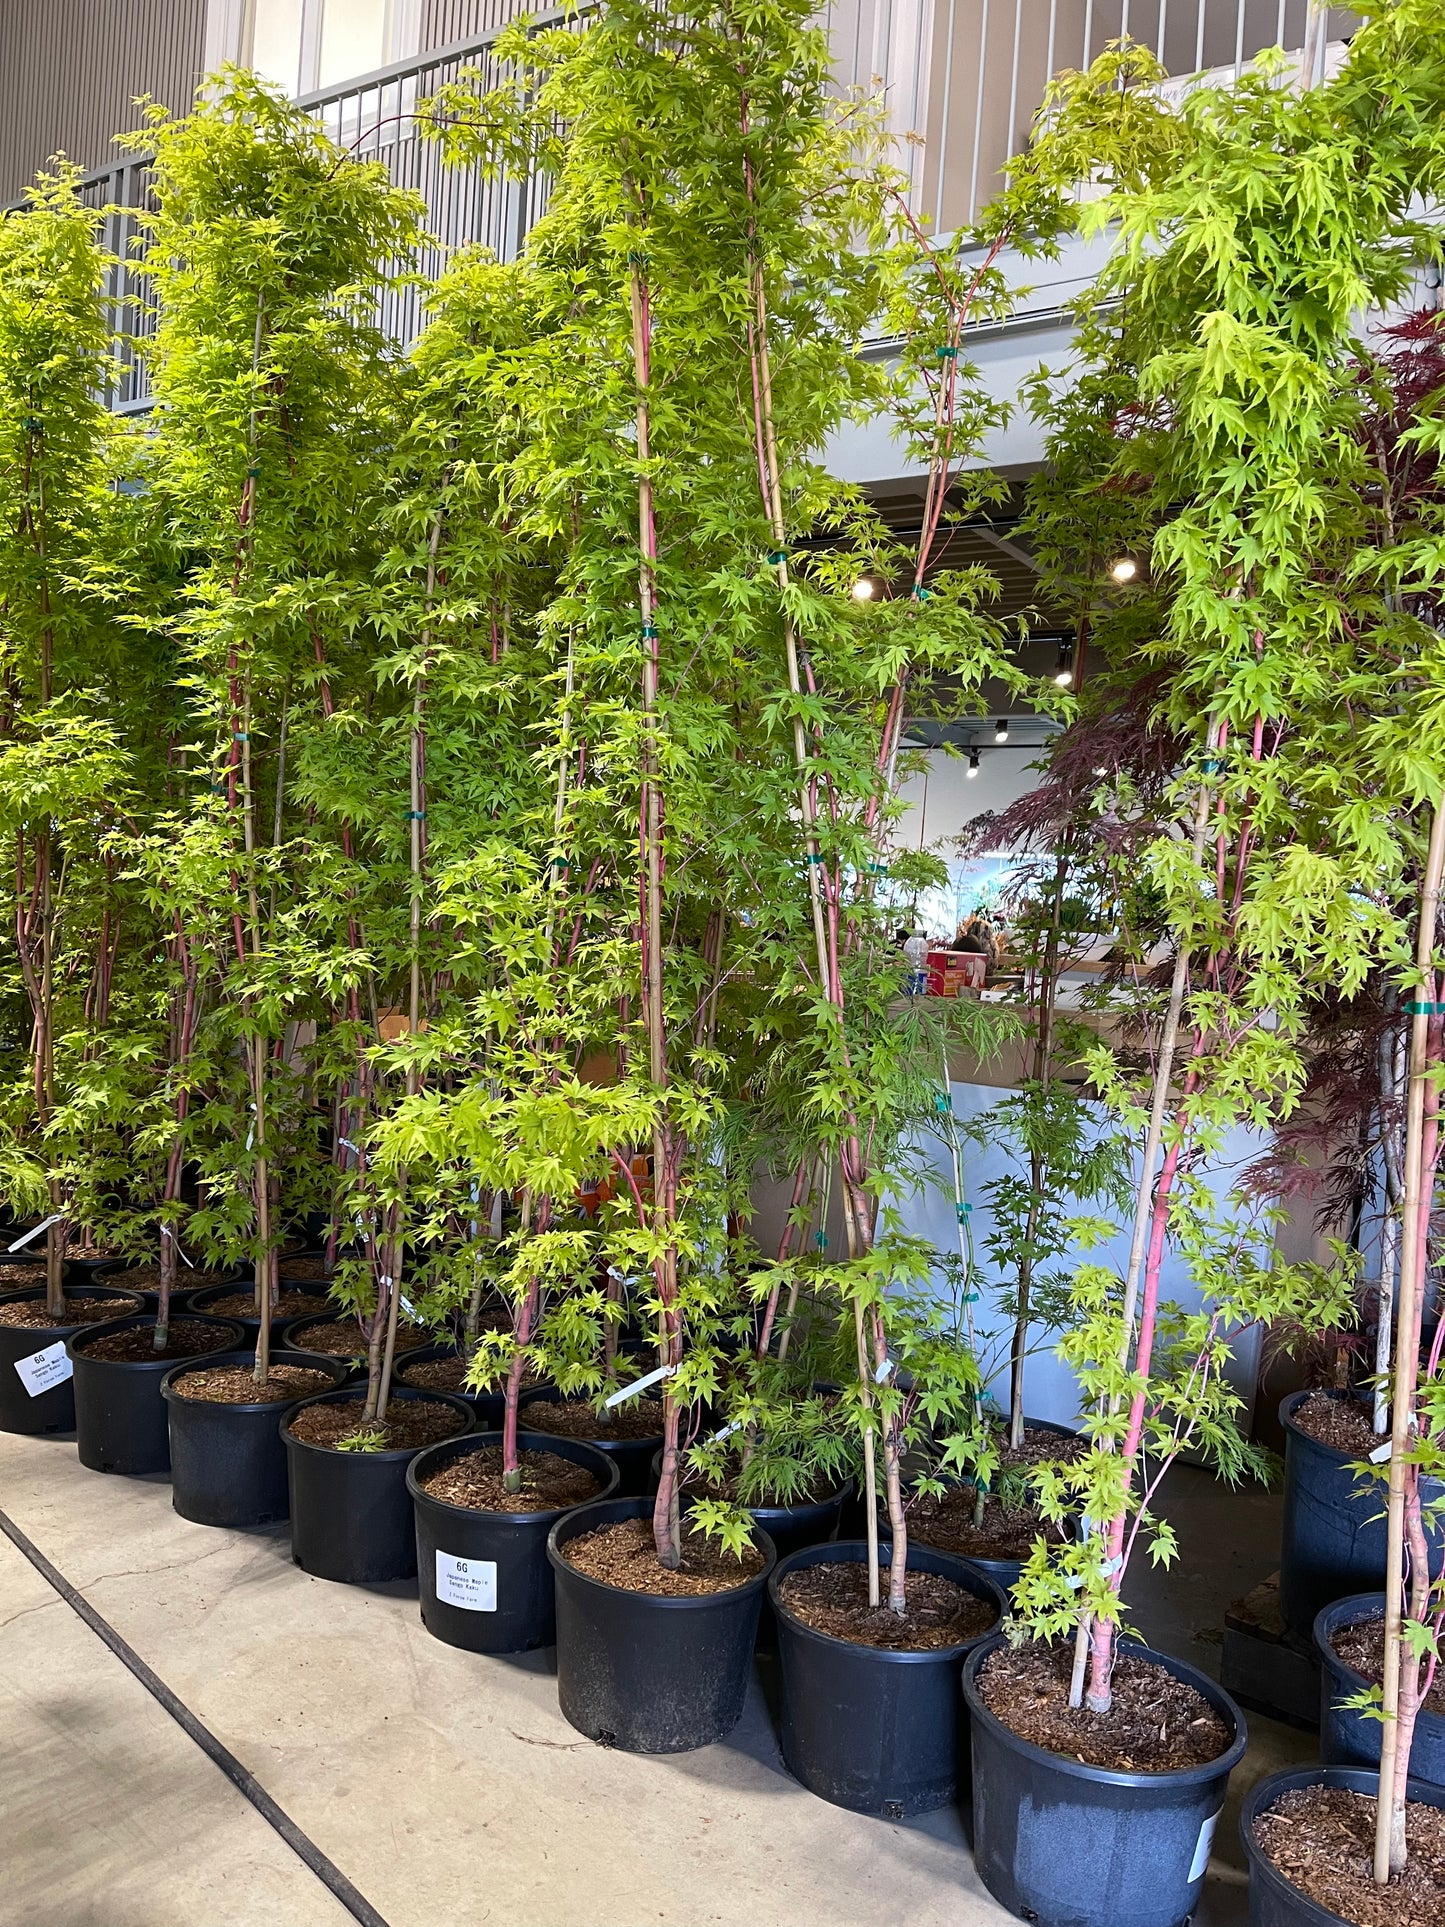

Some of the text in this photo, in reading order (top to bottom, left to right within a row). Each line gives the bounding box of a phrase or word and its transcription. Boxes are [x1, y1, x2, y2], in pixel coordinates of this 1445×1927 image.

[34, 1354, 45, 1364] 6G
[456, 1561, 468, 1573] 6G
[446, 1572, 488, 1586] Japanese Maple
